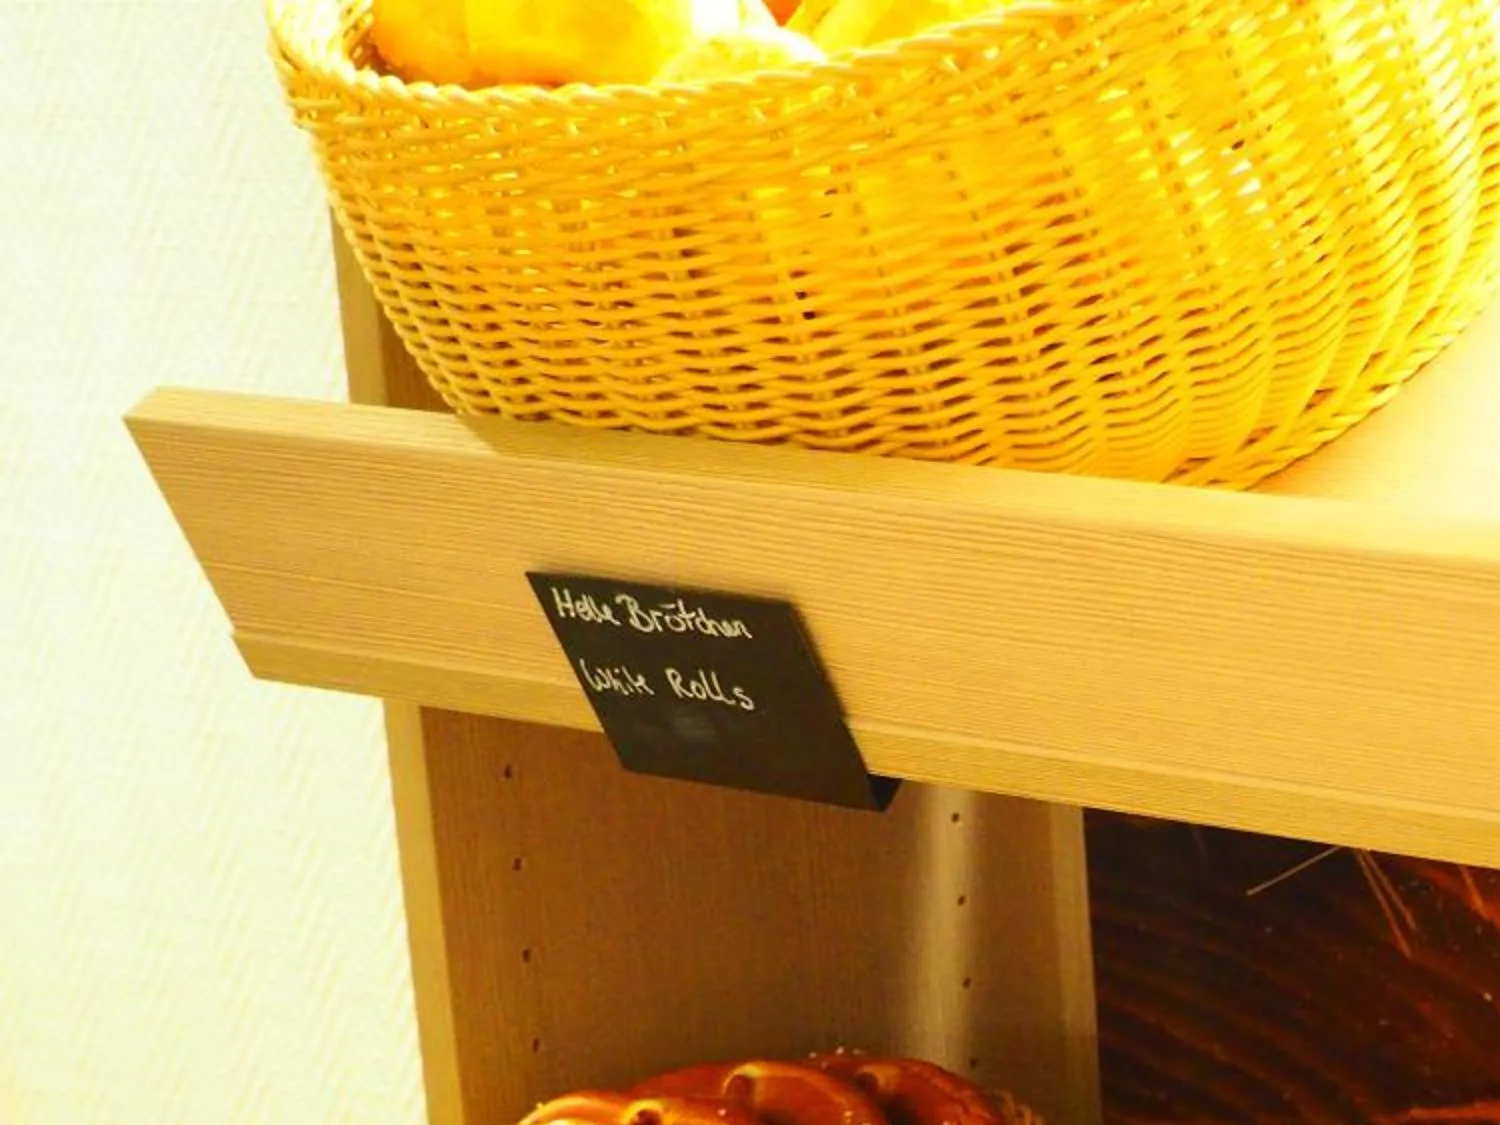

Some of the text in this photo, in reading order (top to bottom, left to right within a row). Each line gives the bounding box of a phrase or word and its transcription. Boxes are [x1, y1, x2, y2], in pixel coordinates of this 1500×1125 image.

[551, 587, 753, 639] Helle Brötchen
[580, 659, 755, 711] White Rolls
